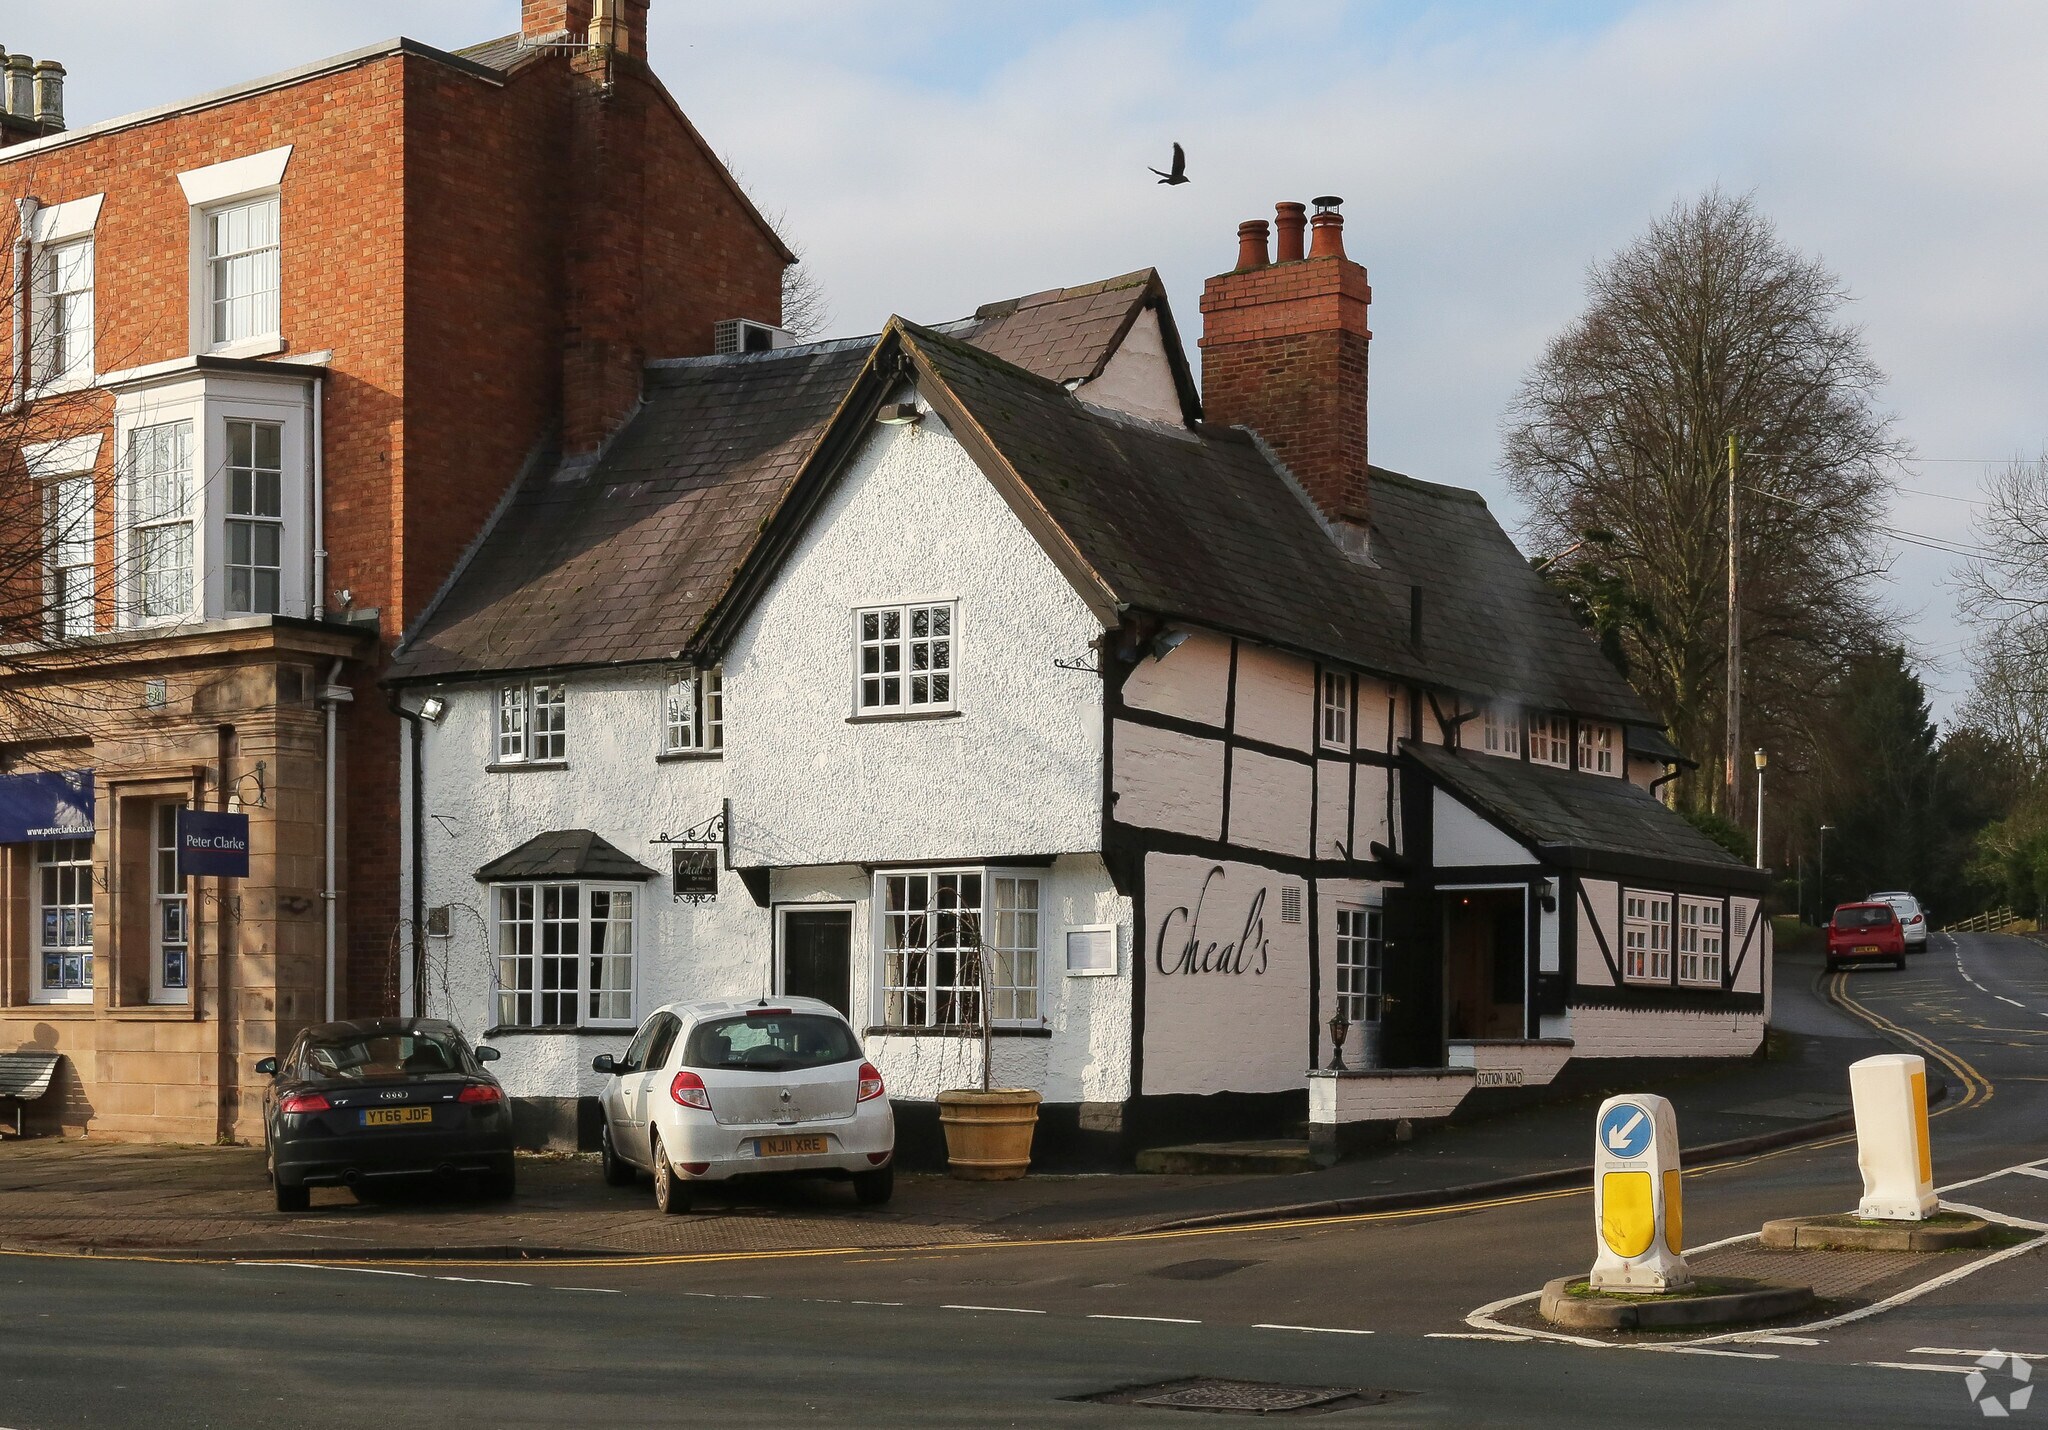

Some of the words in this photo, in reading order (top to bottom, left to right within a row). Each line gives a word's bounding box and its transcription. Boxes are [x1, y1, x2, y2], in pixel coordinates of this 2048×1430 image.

[26, 824, 95, 837] www.peterclarke.co.uk
[186, 834, 212, 848] Peter
[213, 836, 245, 850] Clarke
[678, 851, 712, 875] Cheal's
[1157, 865, 1270, 976] Cheal's
[1477, 1072, 1503, 1085] STATION
[1505, 1071, 1523, 1084] ROAD
[367, 1108, 401, 1123] YT66
[405, 1107, 429, 1121] JDF
[795, 1138, 820, 1150] XRE
